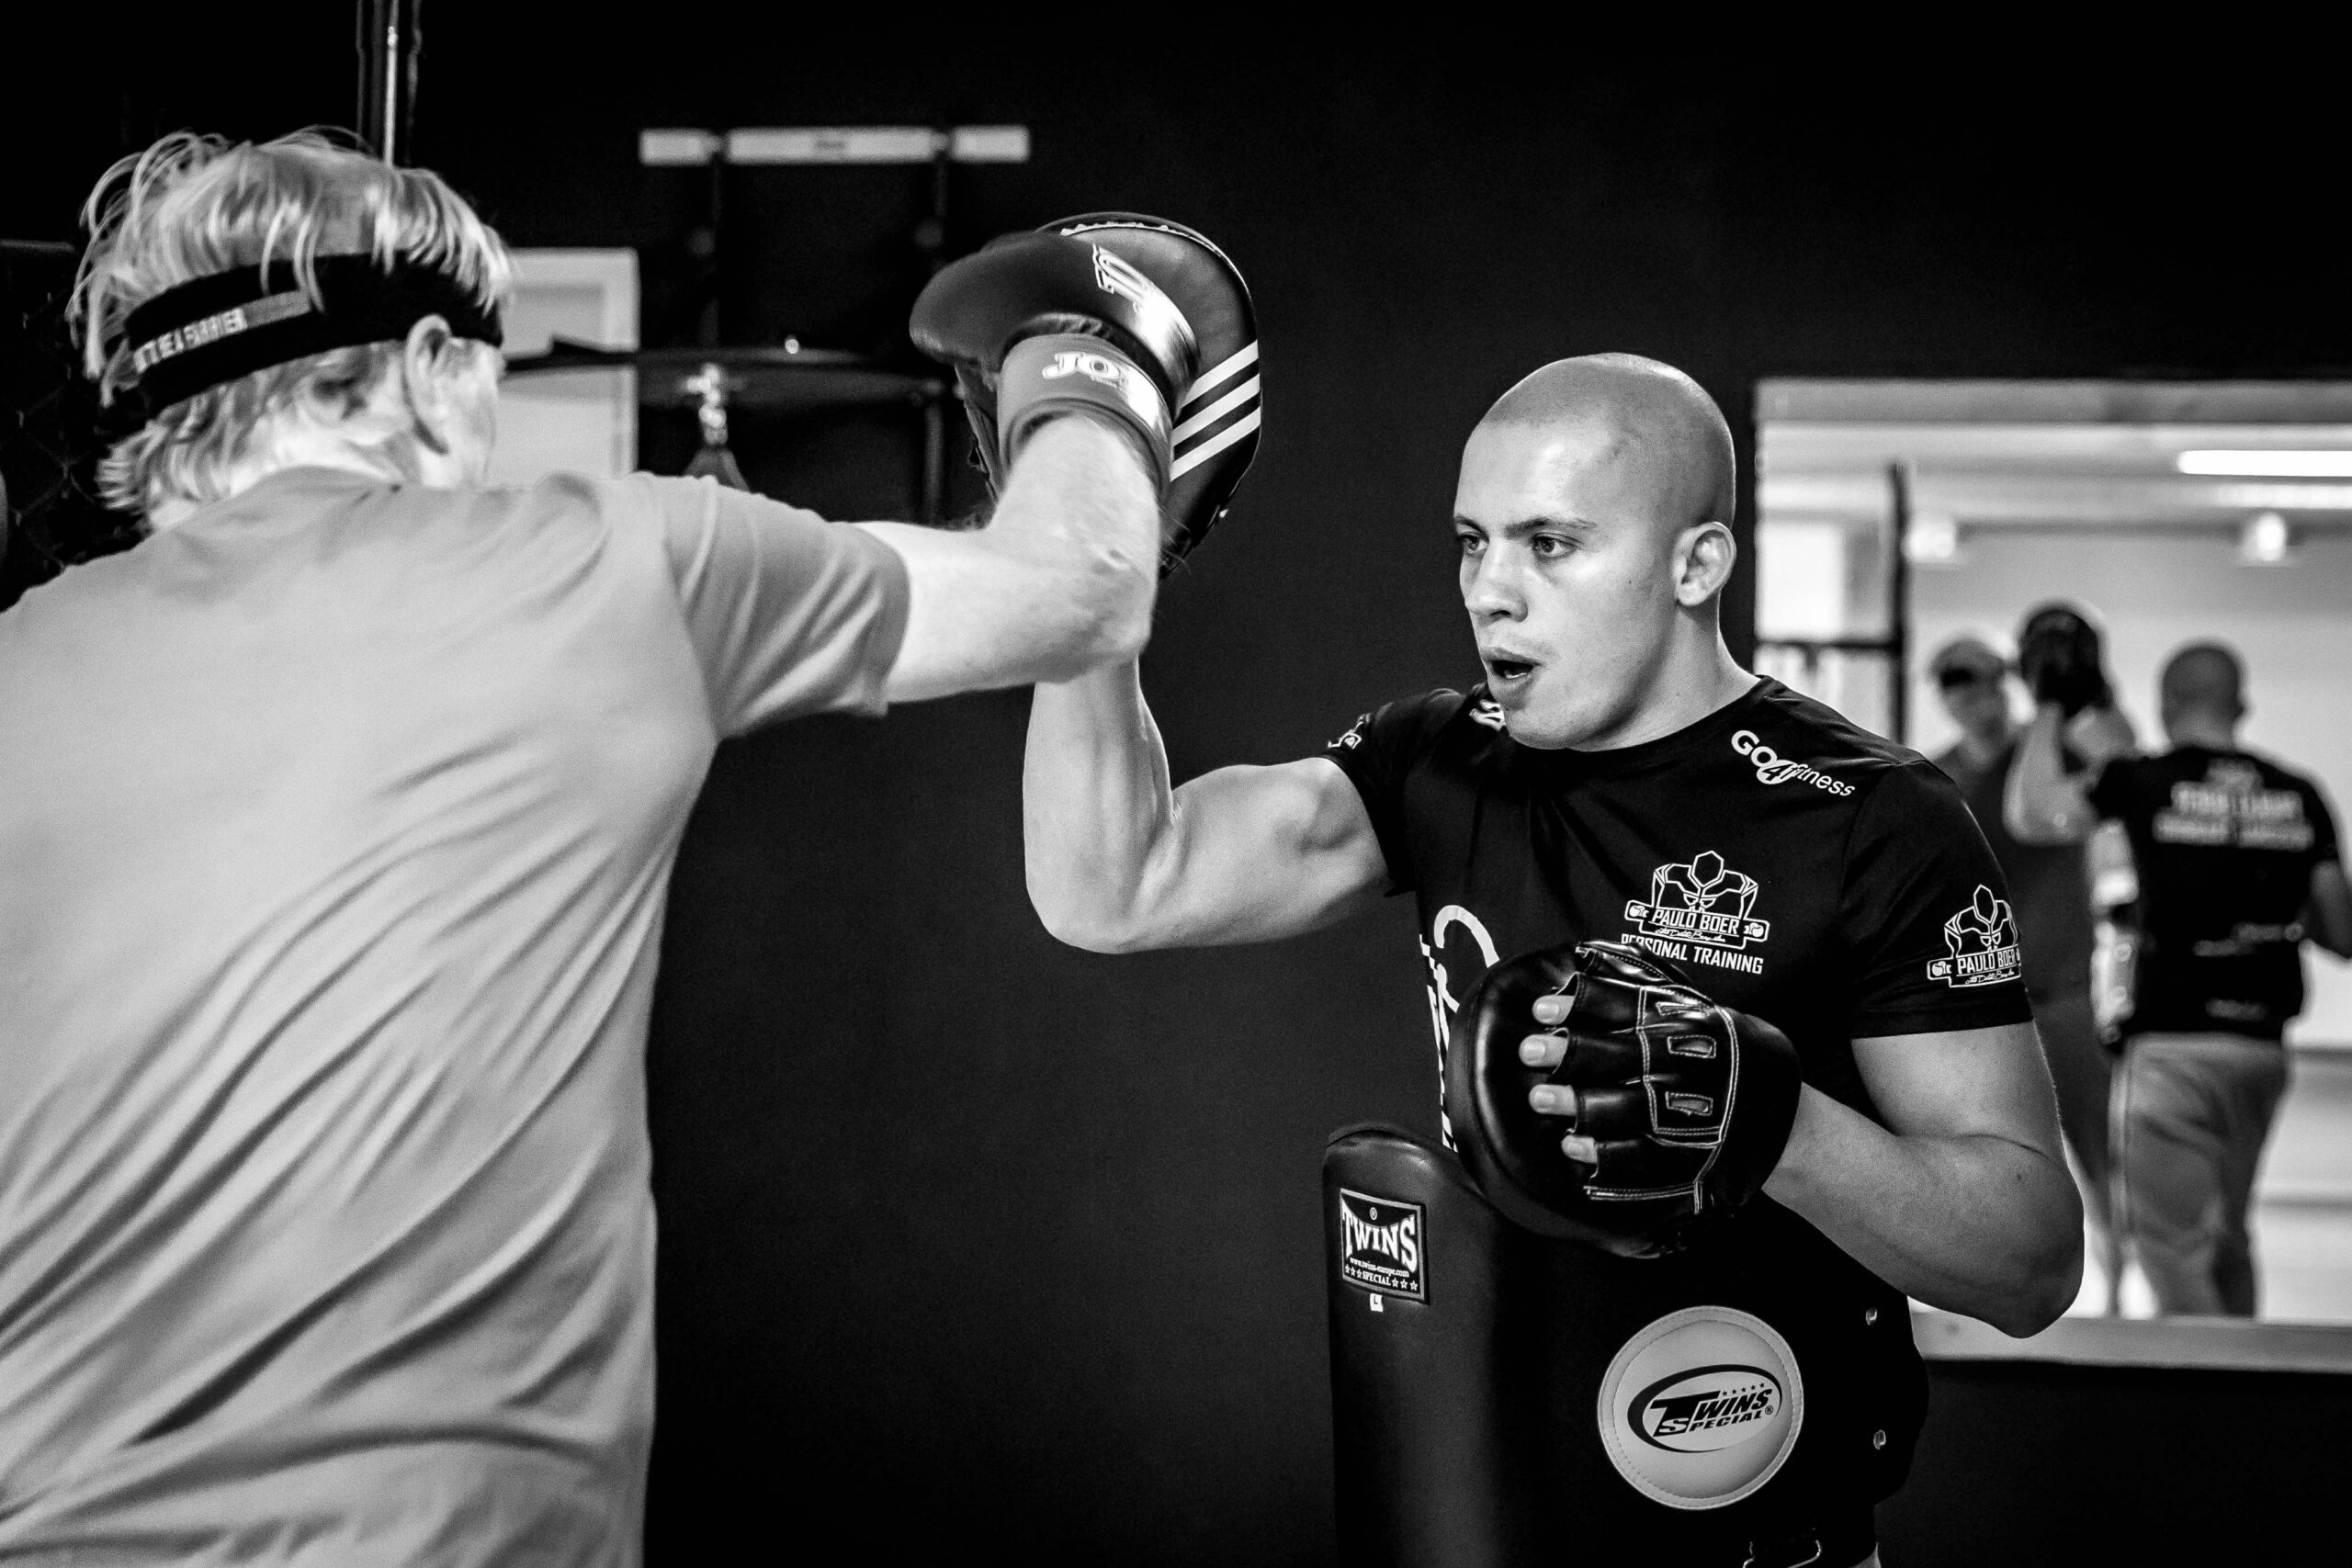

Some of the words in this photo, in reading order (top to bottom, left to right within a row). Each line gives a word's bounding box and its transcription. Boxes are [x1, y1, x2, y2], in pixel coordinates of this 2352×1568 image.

[1652, 908, 1697, 929] PAULO
[1700, 914, 1740, 935] BOER
[1693, 946, 1764, 975] TRAINING
[1957, 953, 1996, 975] PAULO
[1341, 1197, 1418, 1273] TWINS
[1362, 1270, 1391, 1286] SPECIAL
[1650, 1389, 1773, 1437] TWINS
[1658, 1410, 1762, 1434] SPECIAL
